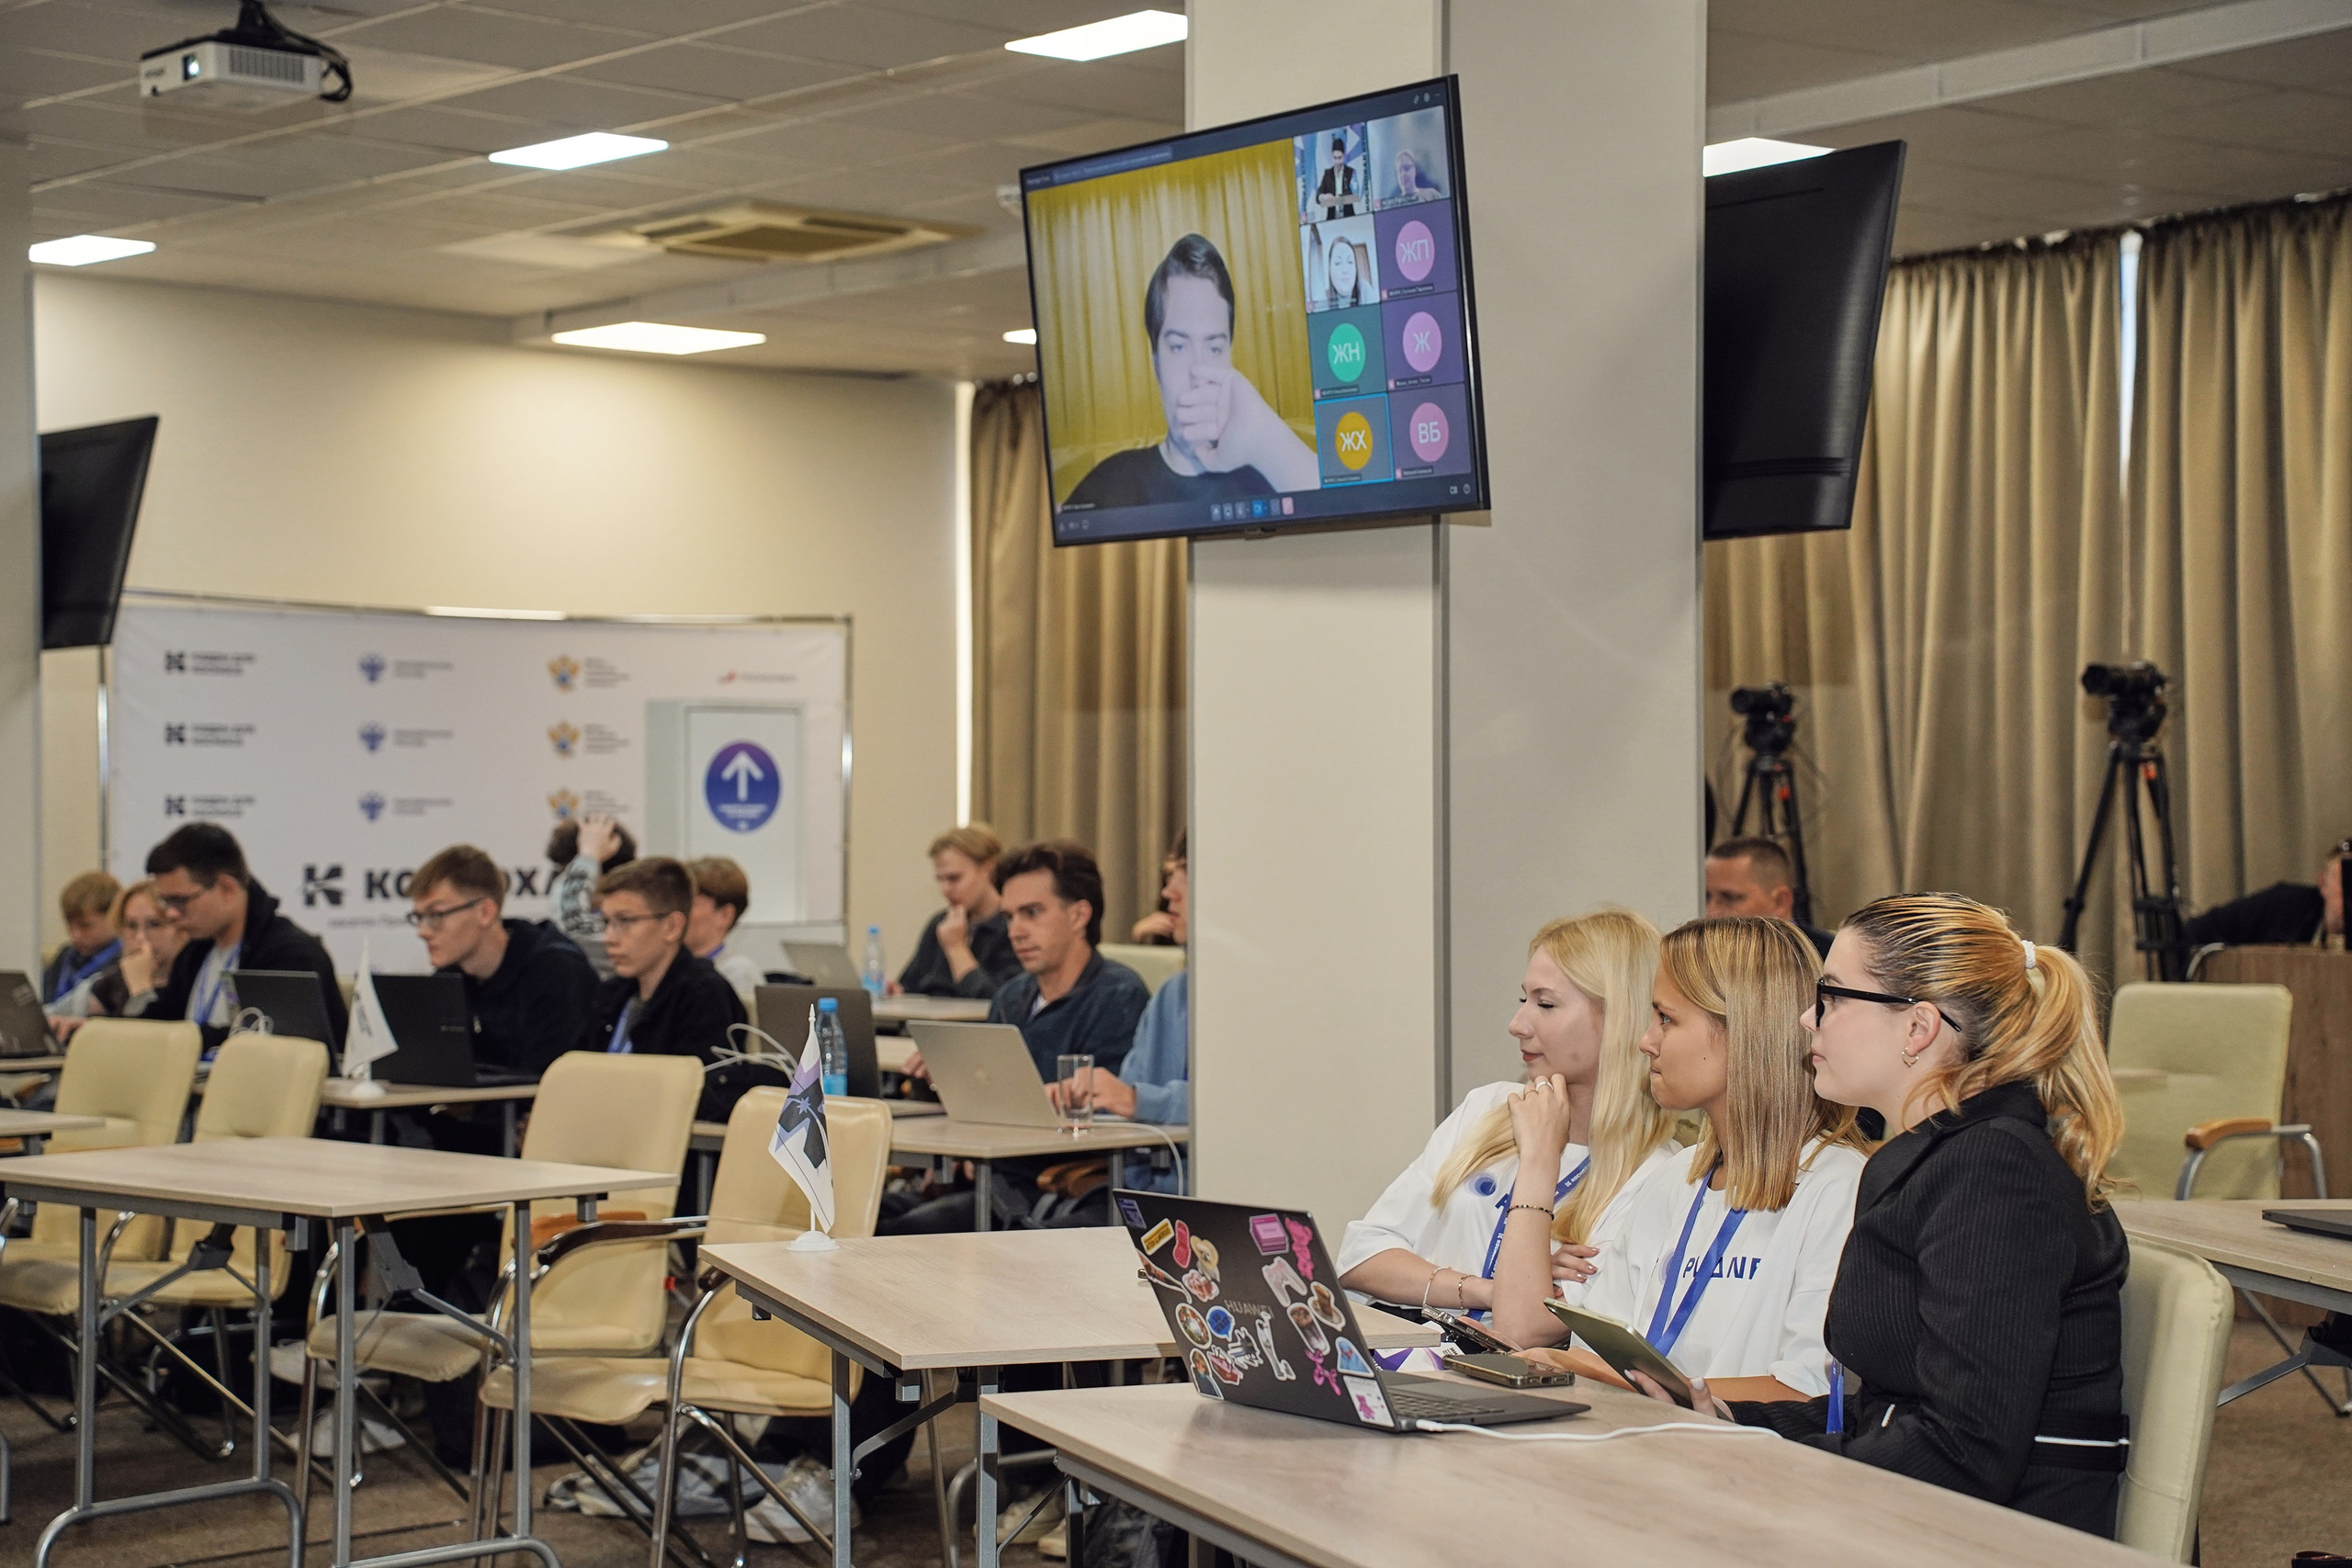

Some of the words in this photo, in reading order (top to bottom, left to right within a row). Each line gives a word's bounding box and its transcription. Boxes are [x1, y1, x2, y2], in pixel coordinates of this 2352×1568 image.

[1399, 239, 1430, 265] ЖП
[1413, 331, 1431, 353] Ж
[1332, 342, 1360, 365] ЖН
[1340, 430, 1367, 451] ЖХ
[1419, 422, 1441, 444] ВБ
